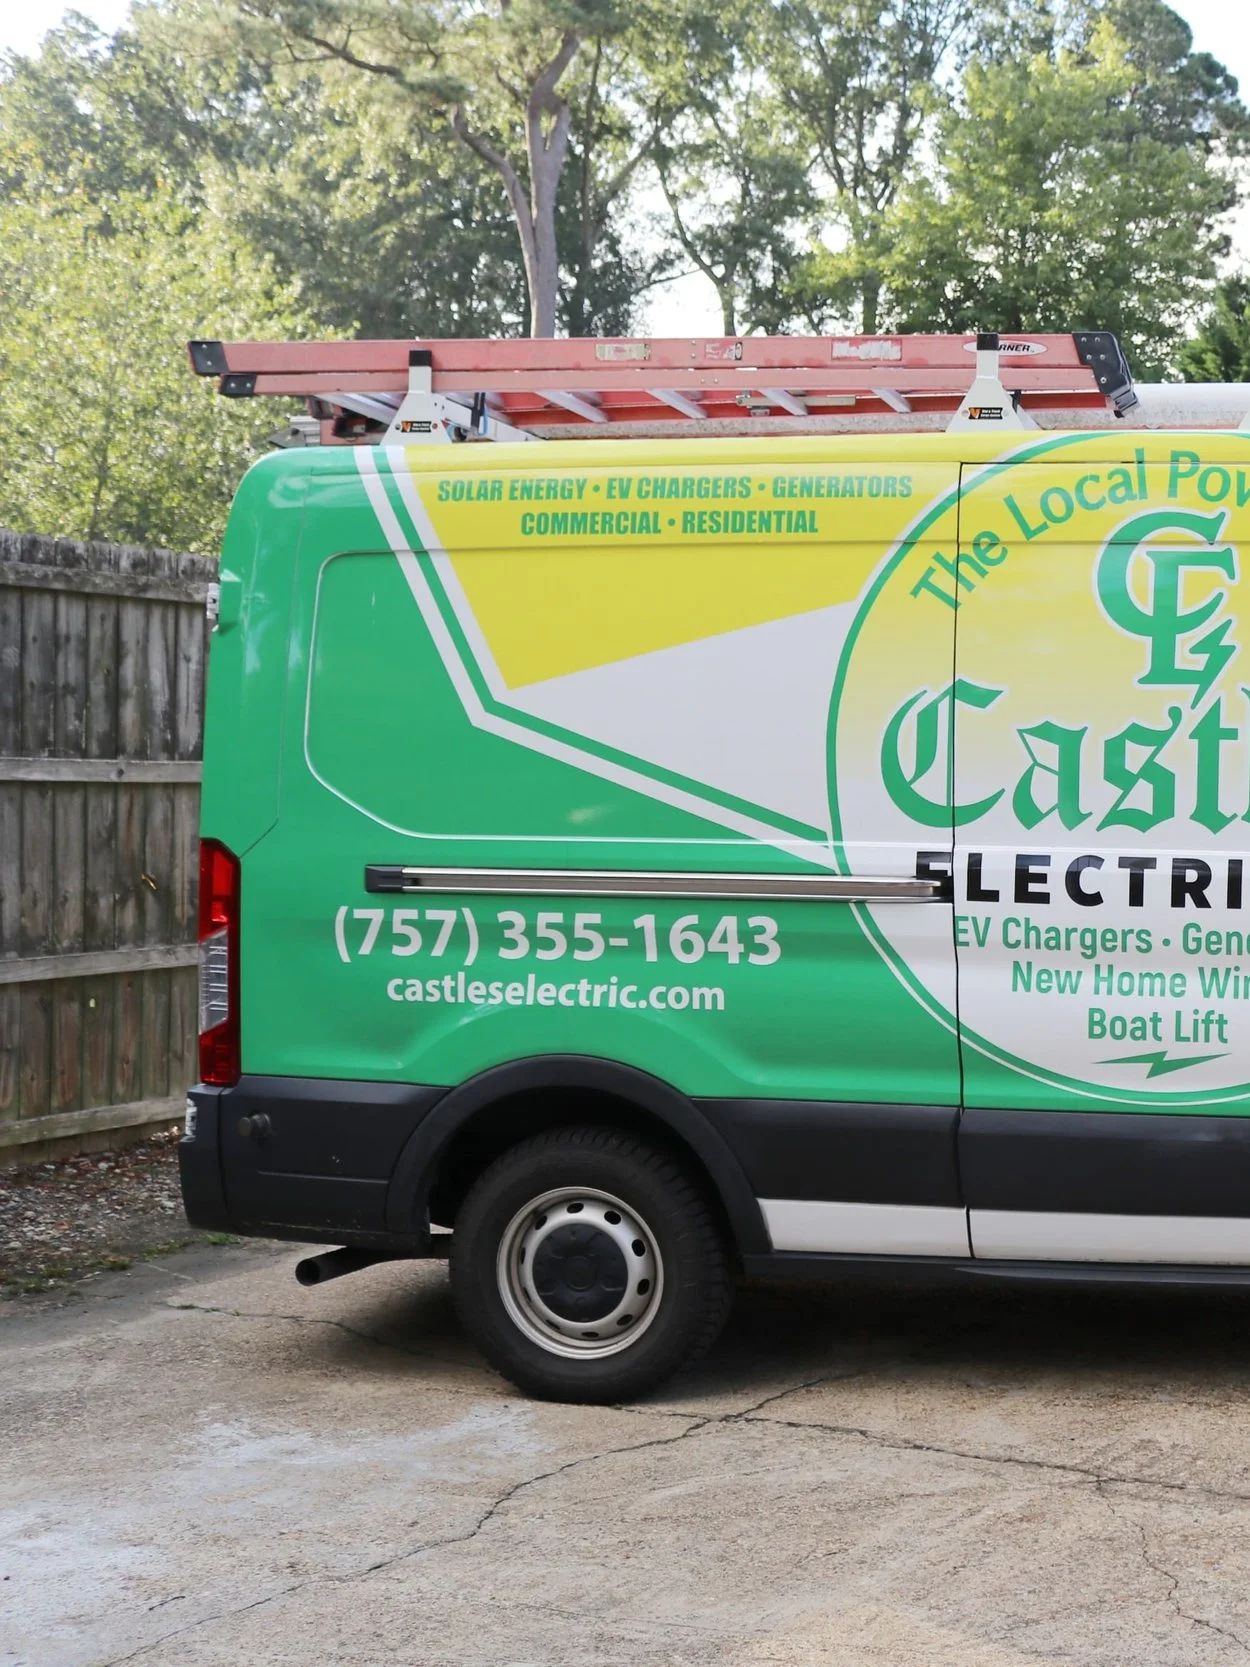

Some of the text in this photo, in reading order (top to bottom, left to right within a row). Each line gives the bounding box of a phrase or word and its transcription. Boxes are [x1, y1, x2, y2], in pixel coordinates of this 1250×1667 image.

[437, 475, 912, 501] SOLAR ENERGY EV CHARGERS GENERATORS
[520, 510, 819, 535] COMMERCIAL RESIDENTIAL
[909, 530, 1008, 610] The
[1003, 448, 1148, 541] Local
[334, 906, 782, 966] (757) 355-1643
[955, 915, 992, 948] EV
[1001, 917, 1153, 960] Chargers
[386, 971, 726, 1010] castleselectric.com
[1011, 960, 1083, 995] New
[1093, 963, 1187, 998] Home
[1087, 1007, 1229, 1044] Boat Lift
